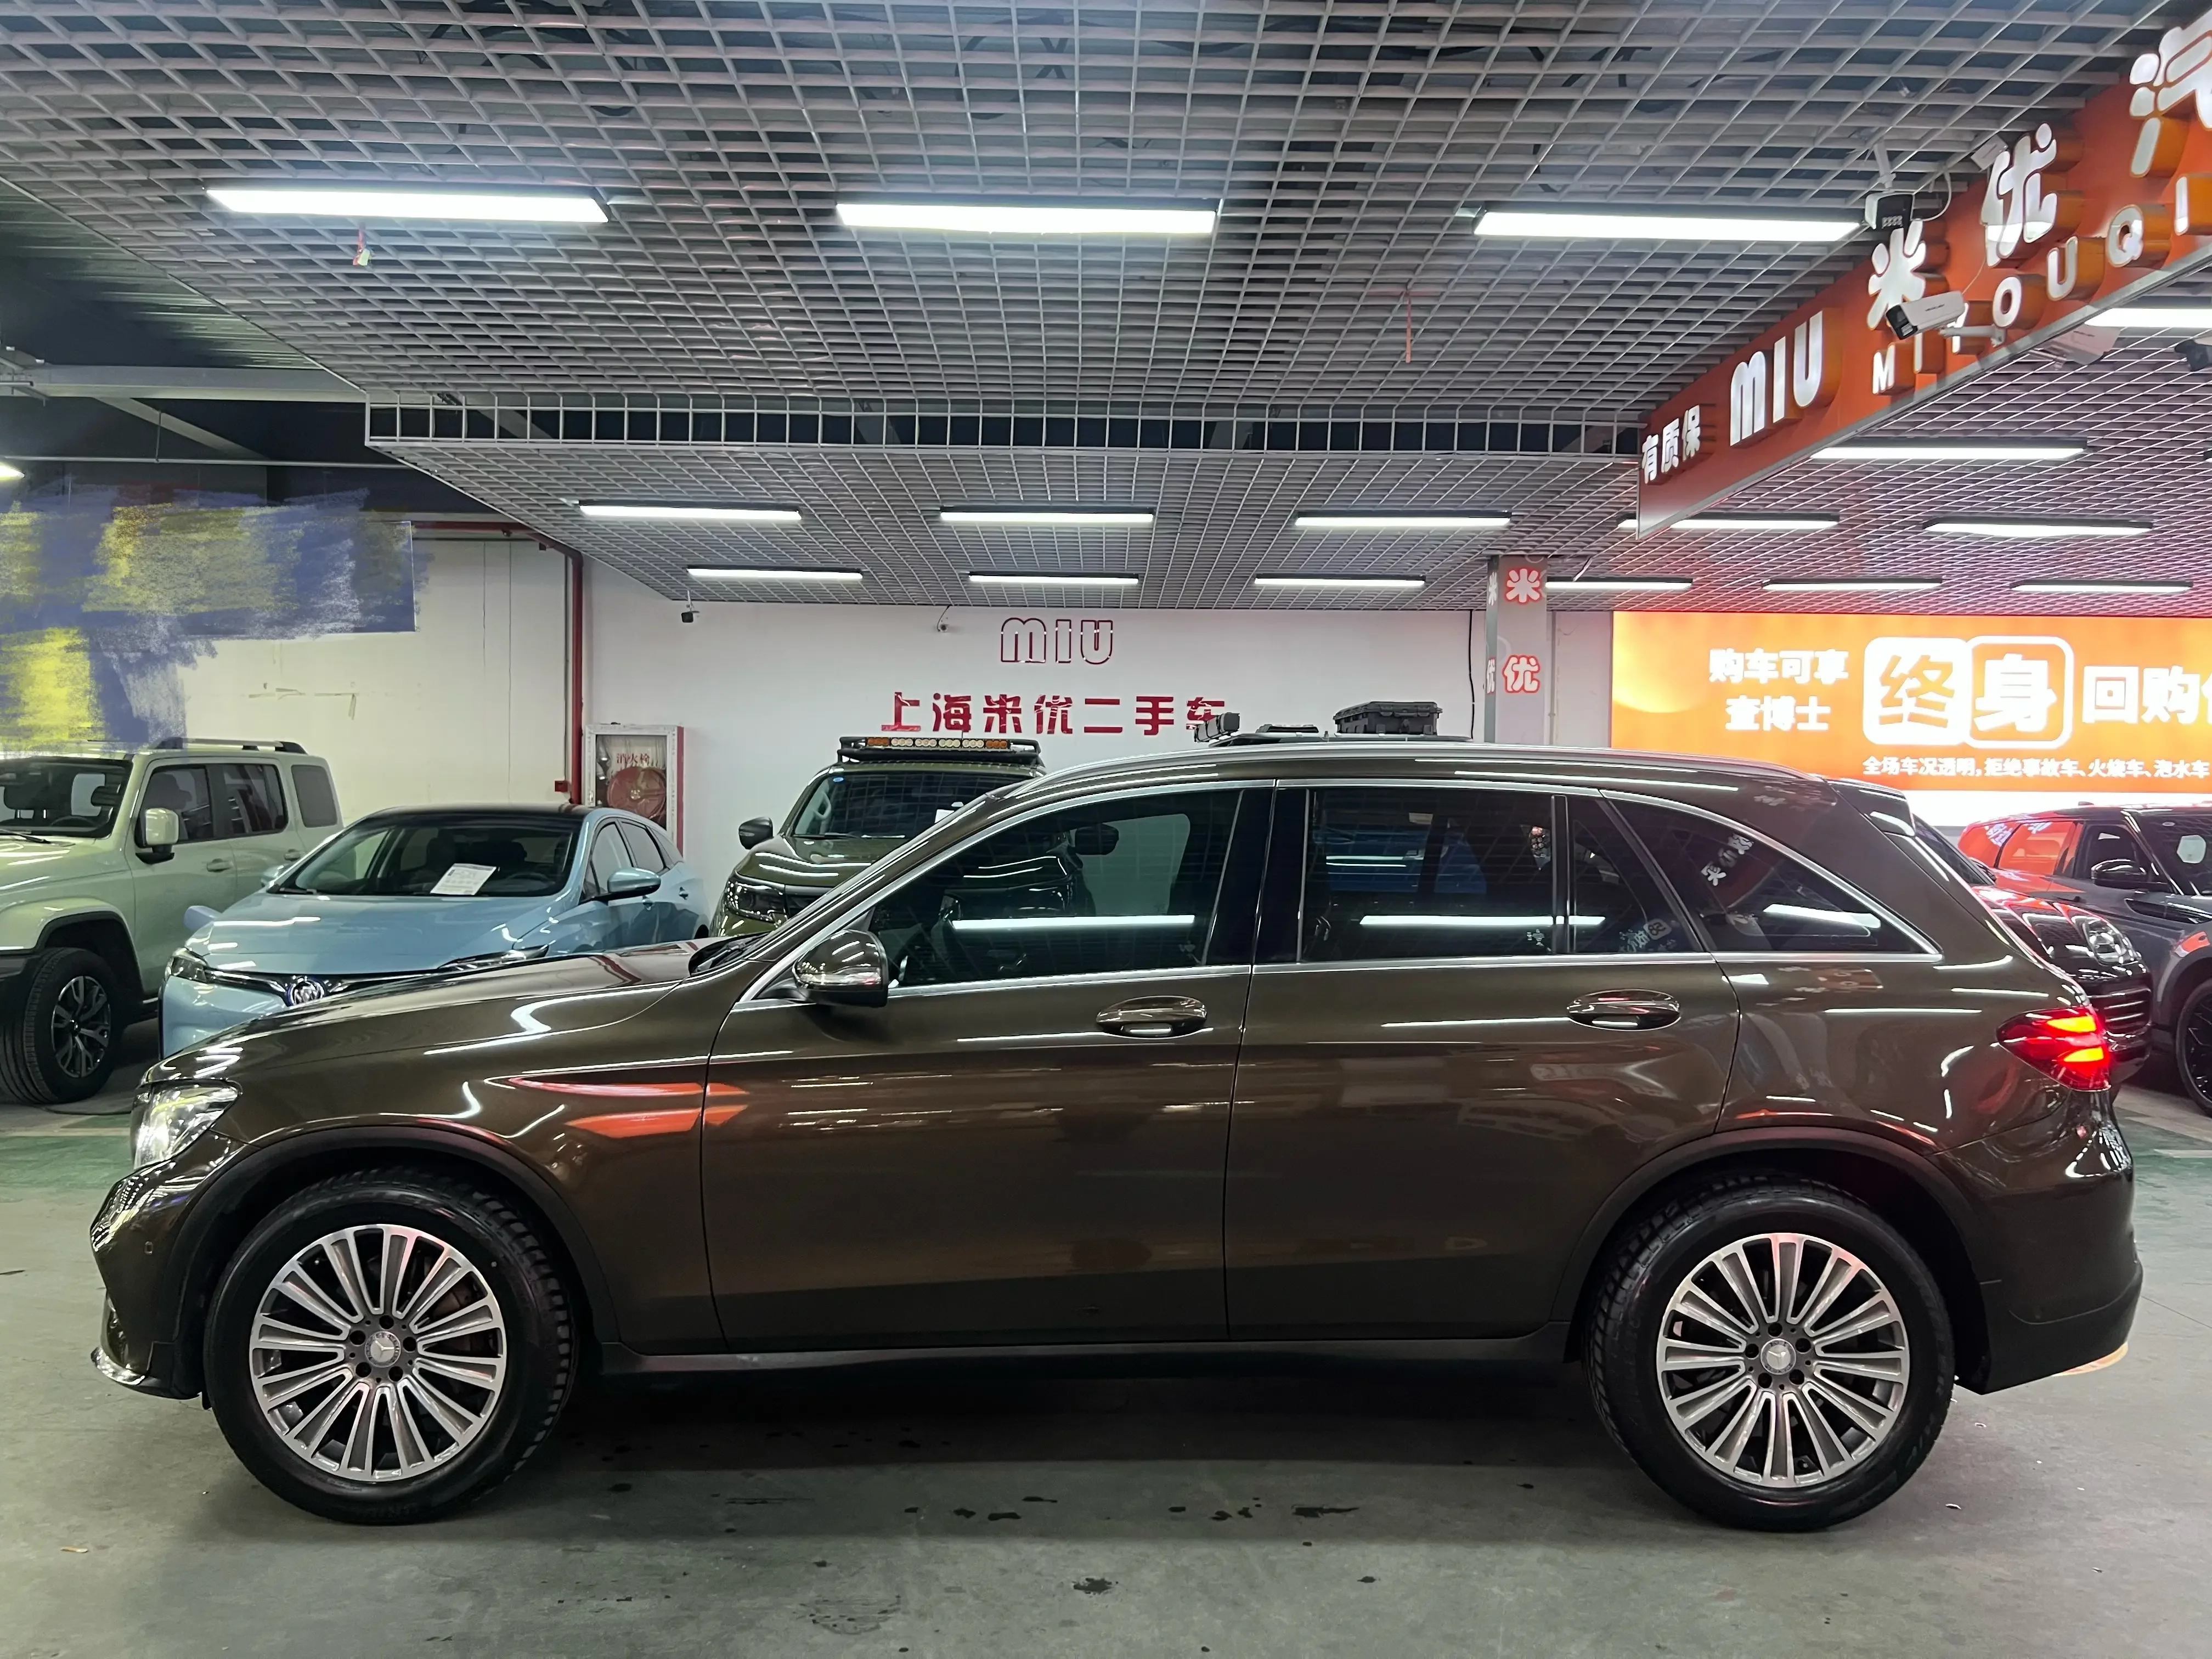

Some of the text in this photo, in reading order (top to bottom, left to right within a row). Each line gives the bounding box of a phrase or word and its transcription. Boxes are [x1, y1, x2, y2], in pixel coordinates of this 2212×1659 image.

[1729, 310, 1824, 447] MIU
[1641, 404, 1701, 484] 有质保
[1001, 617, 1113, 665] MIU
[2083, 665, 2212, 724] 回购
